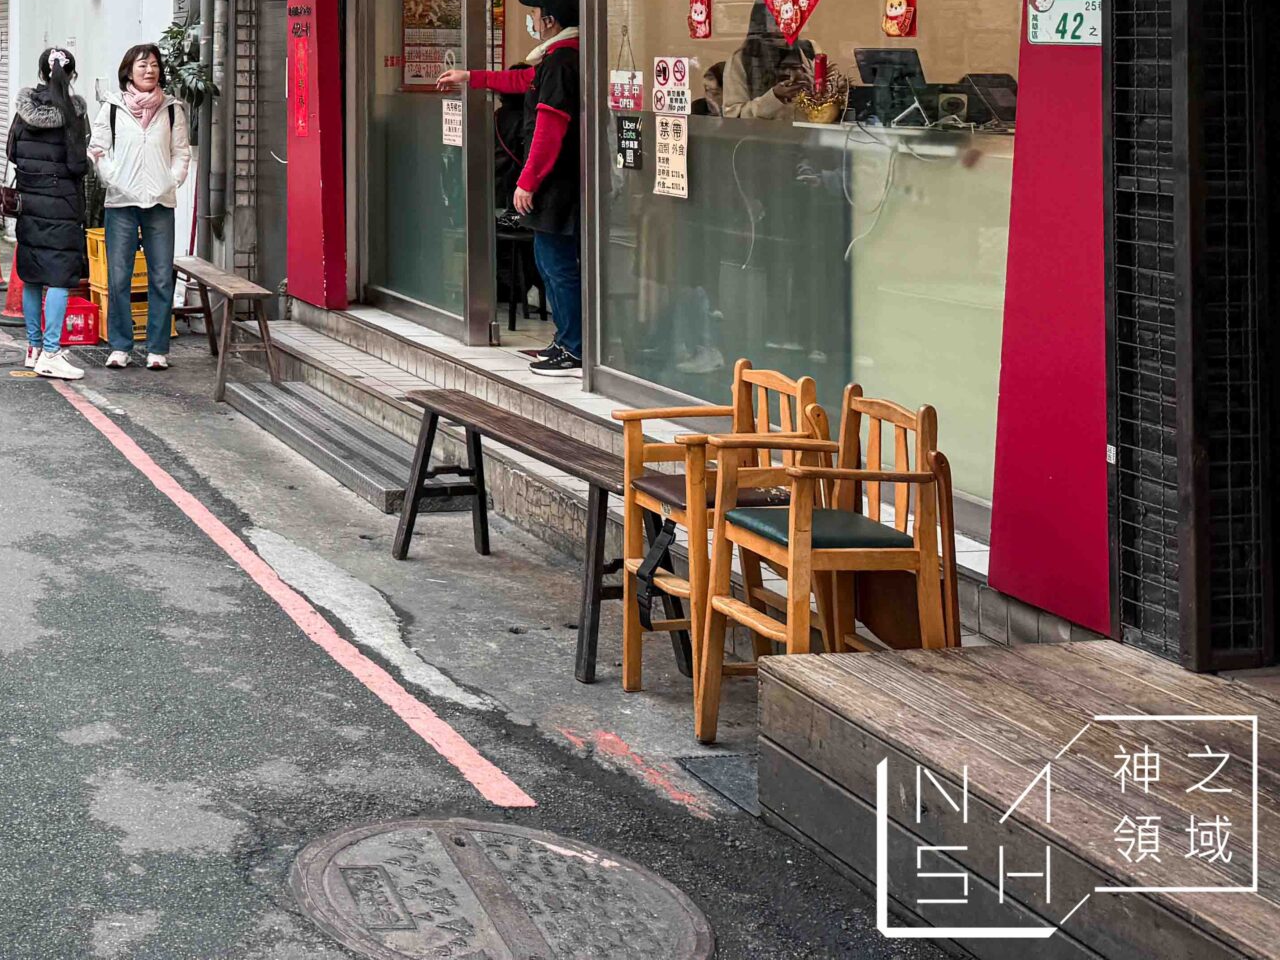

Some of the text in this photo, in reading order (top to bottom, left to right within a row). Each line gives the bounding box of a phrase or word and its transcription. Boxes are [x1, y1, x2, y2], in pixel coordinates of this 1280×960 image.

[1055, 12, 1084, 40] 42
[614, 82, 639, 97] 營業中
[620, 99, 633, 108] OPEN
[623, 120, 635, 129] Uber
[660, 120, 670, 138] 禁
[623, 129, 636, 139] Eats
